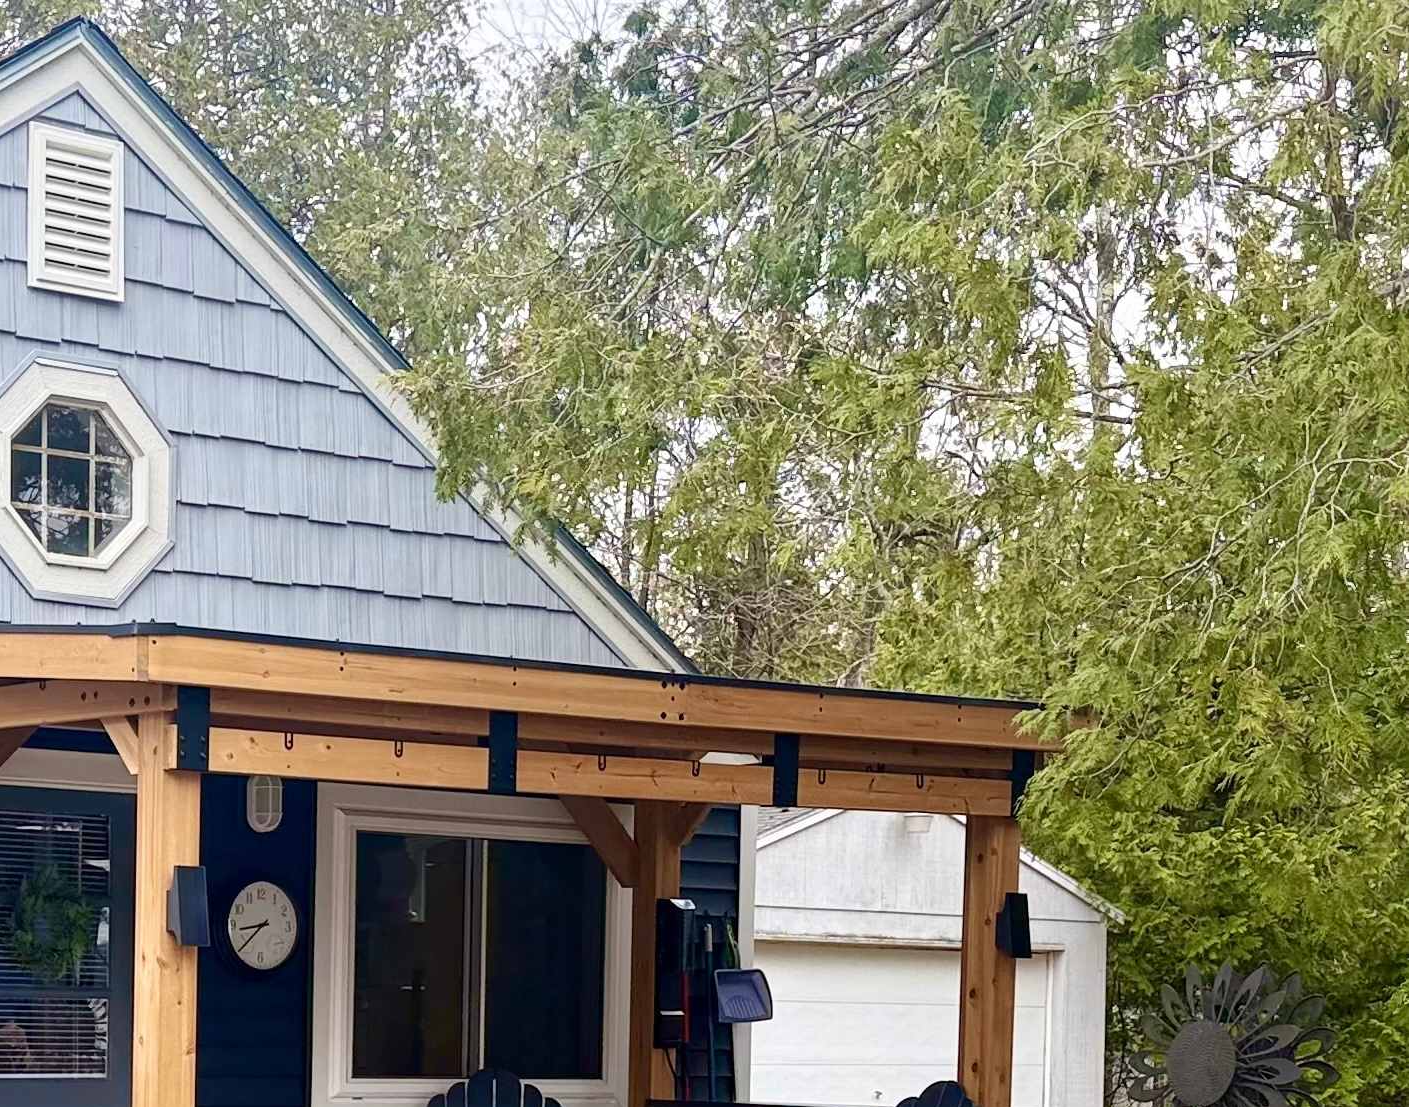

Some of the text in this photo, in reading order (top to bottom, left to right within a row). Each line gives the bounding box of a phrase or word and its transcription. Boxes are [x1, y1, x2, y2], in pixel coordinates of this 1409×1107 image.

[246, 892, 253, 904] 11
[257, 888, 266, 900] 12
[280, 904, 288, 917] 2
[230, 919, 237, 932] 9
